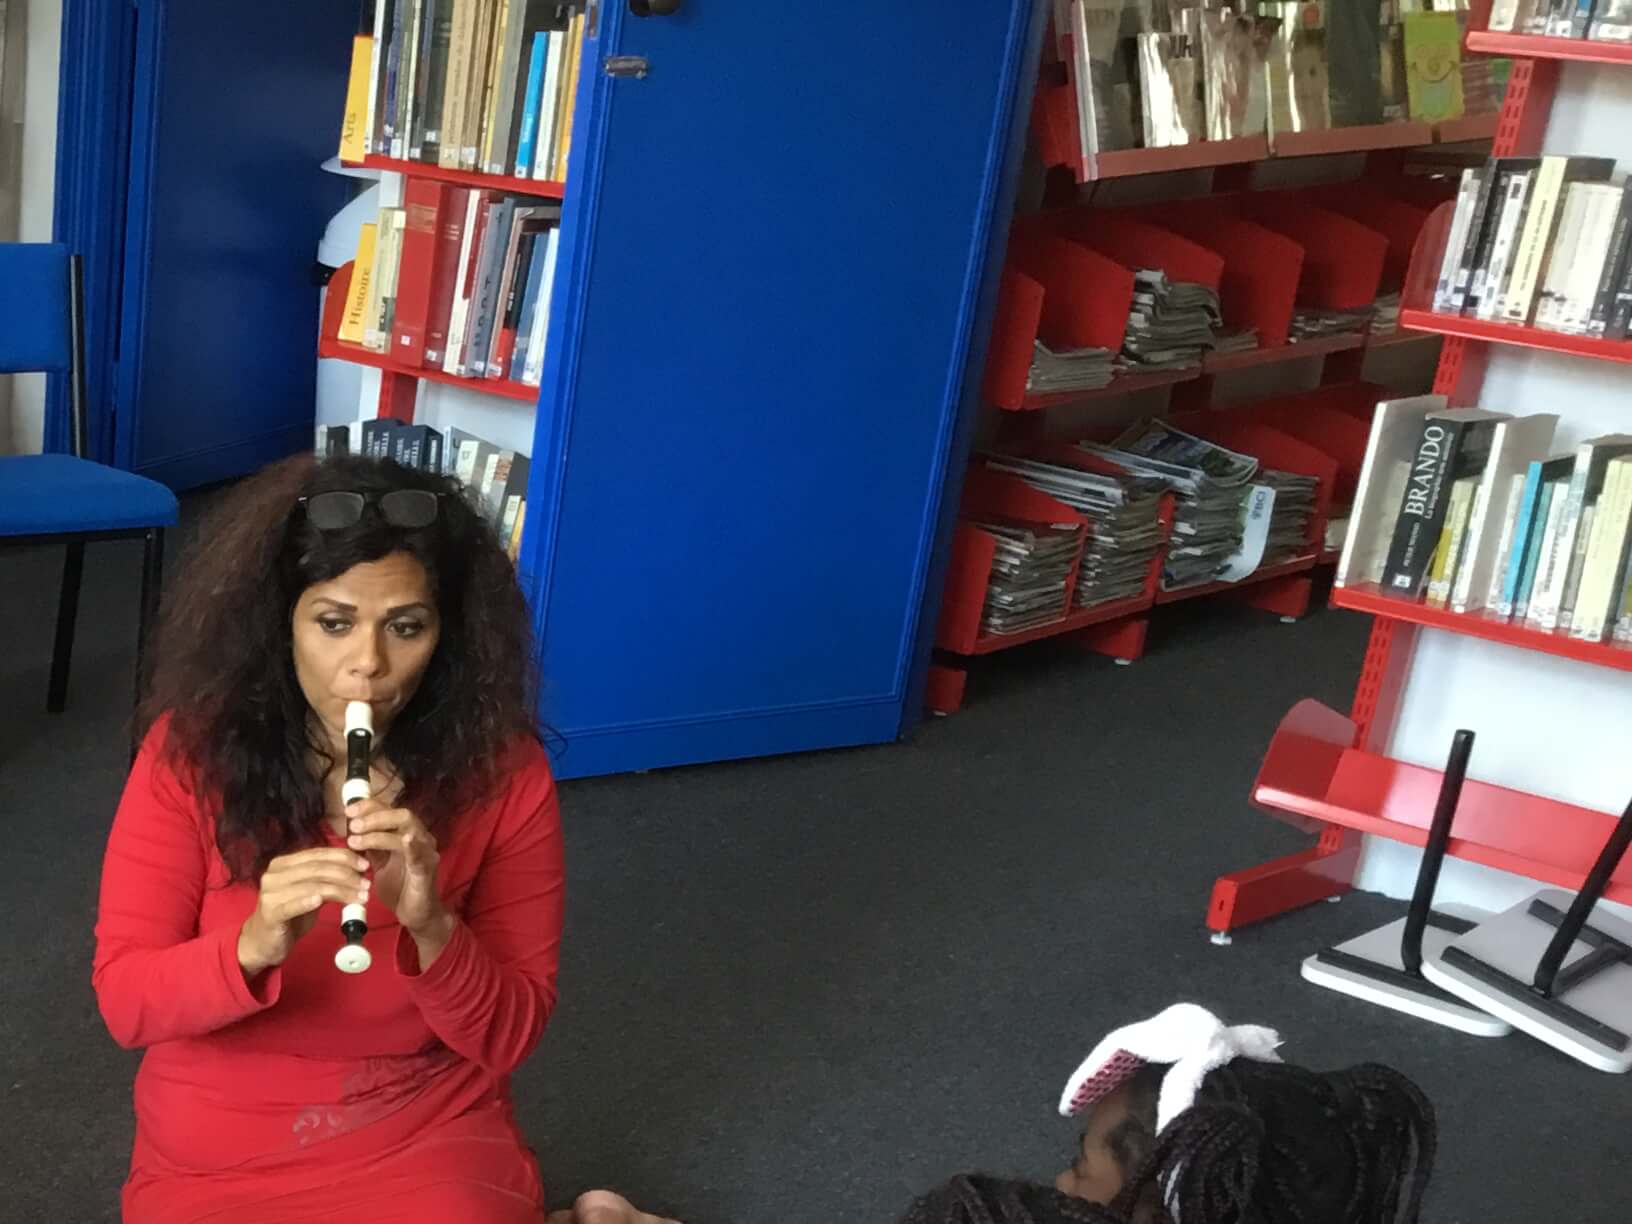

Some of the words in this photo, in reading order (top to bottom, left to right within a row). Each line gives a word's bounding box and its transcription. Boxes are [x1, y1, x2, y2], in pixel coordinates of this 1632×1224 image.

[343, 112, 356, 145] Arts
[349, 267, 369, 325] Histoire
[1404, 425, 1445, 516] BRANDO
